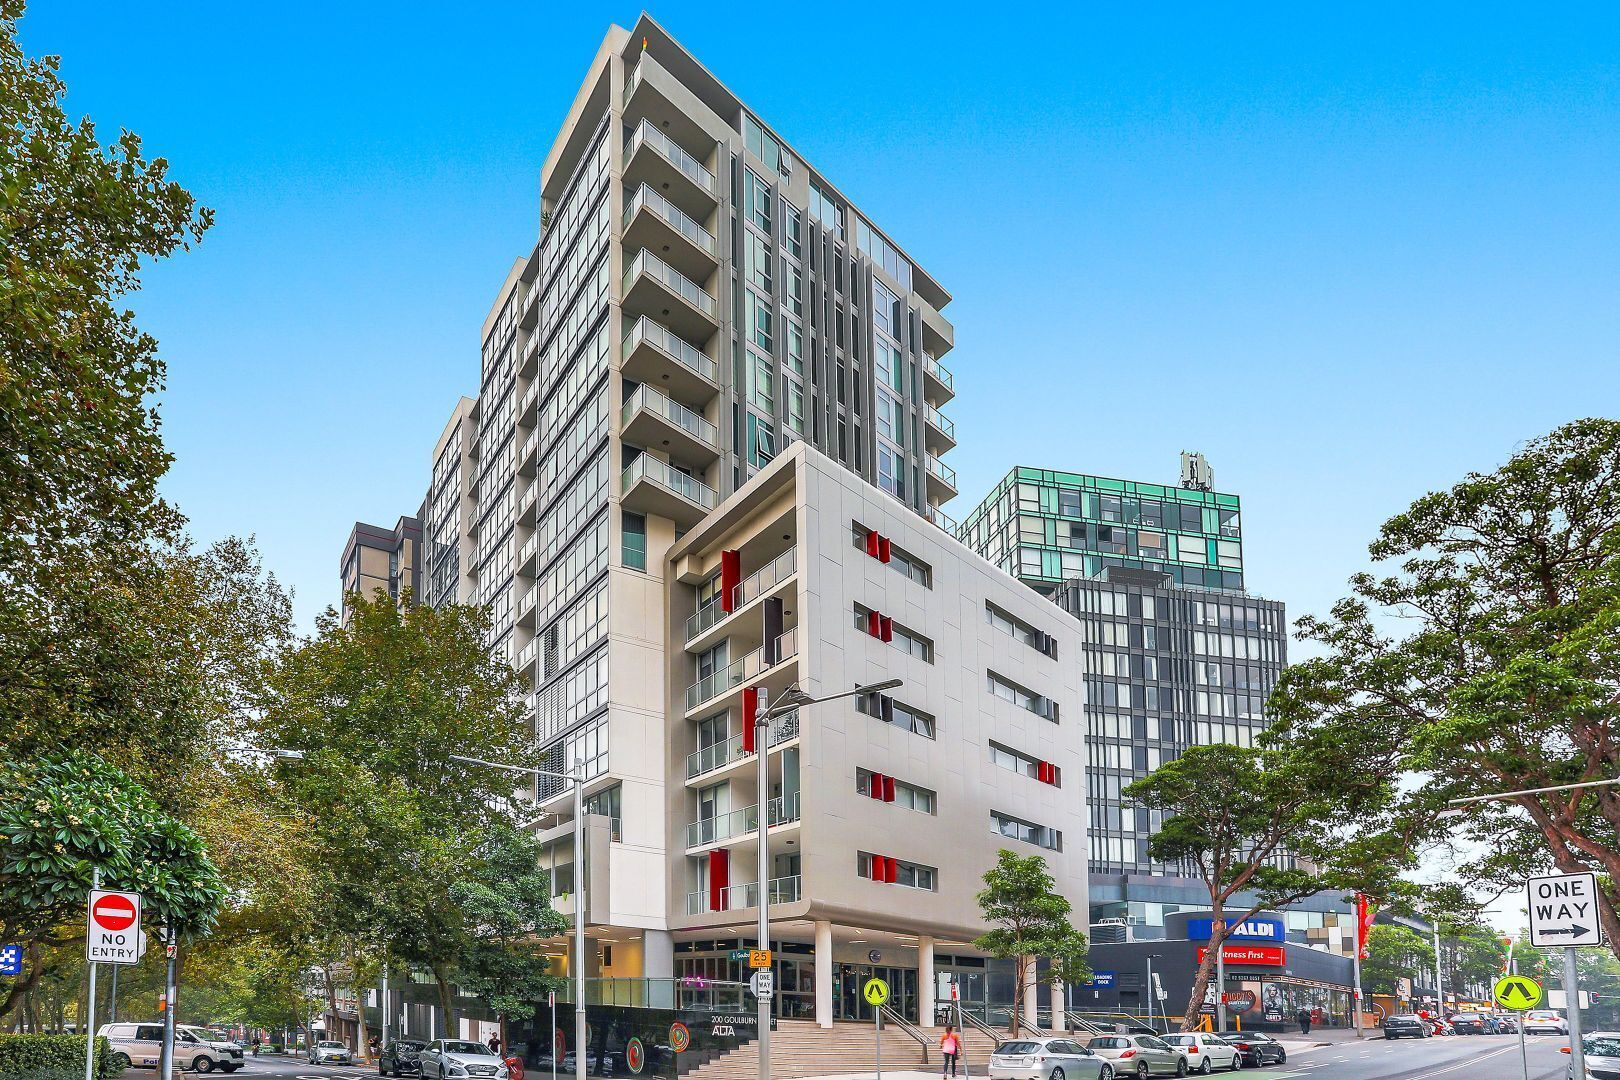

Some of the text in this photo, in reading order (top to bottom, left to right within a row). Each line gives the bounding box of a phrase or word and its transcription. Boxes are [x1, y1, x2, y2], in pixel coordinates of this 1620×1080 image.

[1538, 880, 1585, 899] ONE
[1536, 902, 1589, 921] WAY
[1233, 922, 1274, 937] ALDI
[102, 933, 126, 946] NO
[92, 946, 135, 958] ENTRY
[753, 952, 767, 961] 25
[711, 1015, 757, 1025] 200 GOULBURN
[711, 1025, 736, 1037] ALTA
